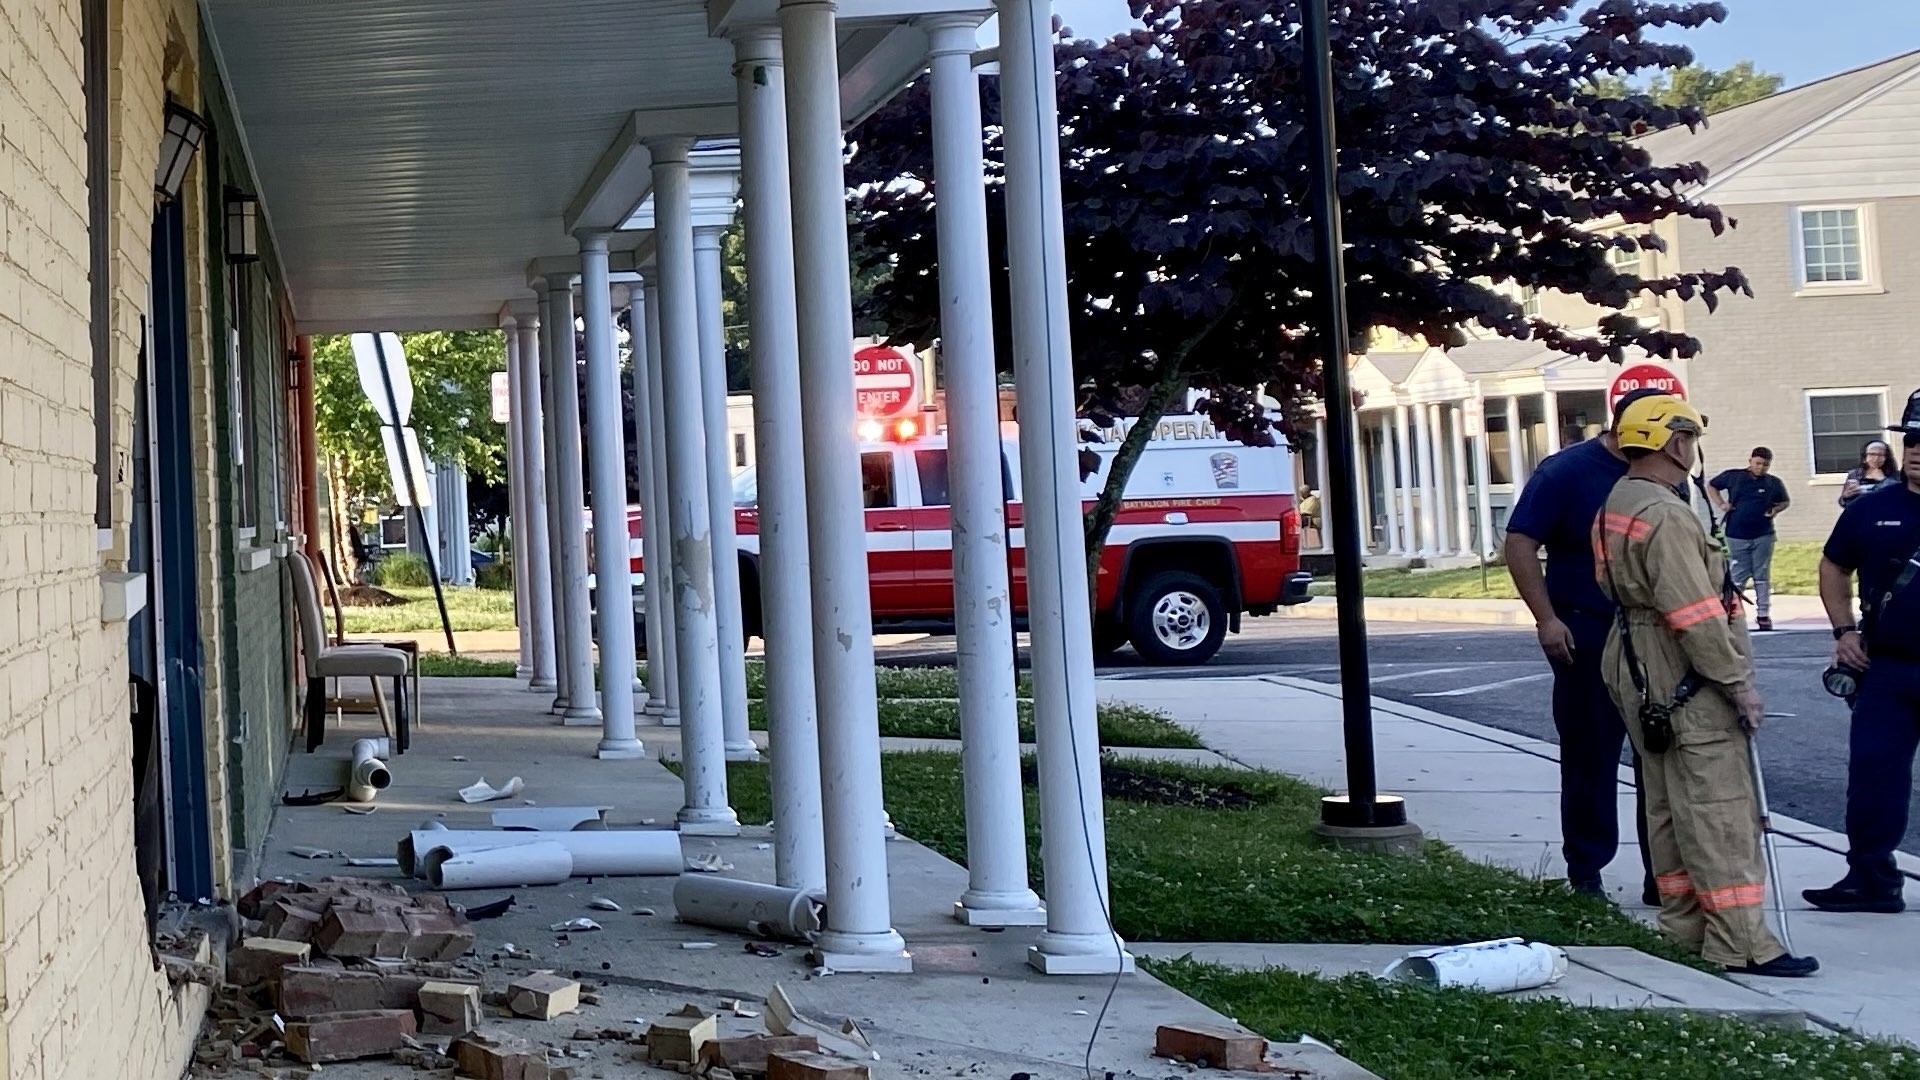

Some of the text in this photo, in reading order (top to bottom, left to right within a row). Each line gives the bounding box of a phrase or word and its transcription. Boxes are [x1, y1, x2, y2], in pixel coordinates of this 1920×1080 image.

[854, 359, 903, 372] DO NOT
[1620, 378, 1674, 391] DO NOT
[858, 391, 901, 403] ENTER
[1150, 420, 1222, 441] OPERA
[1123, 498, 1222, 509] BATTALION FIRE CHIEF
